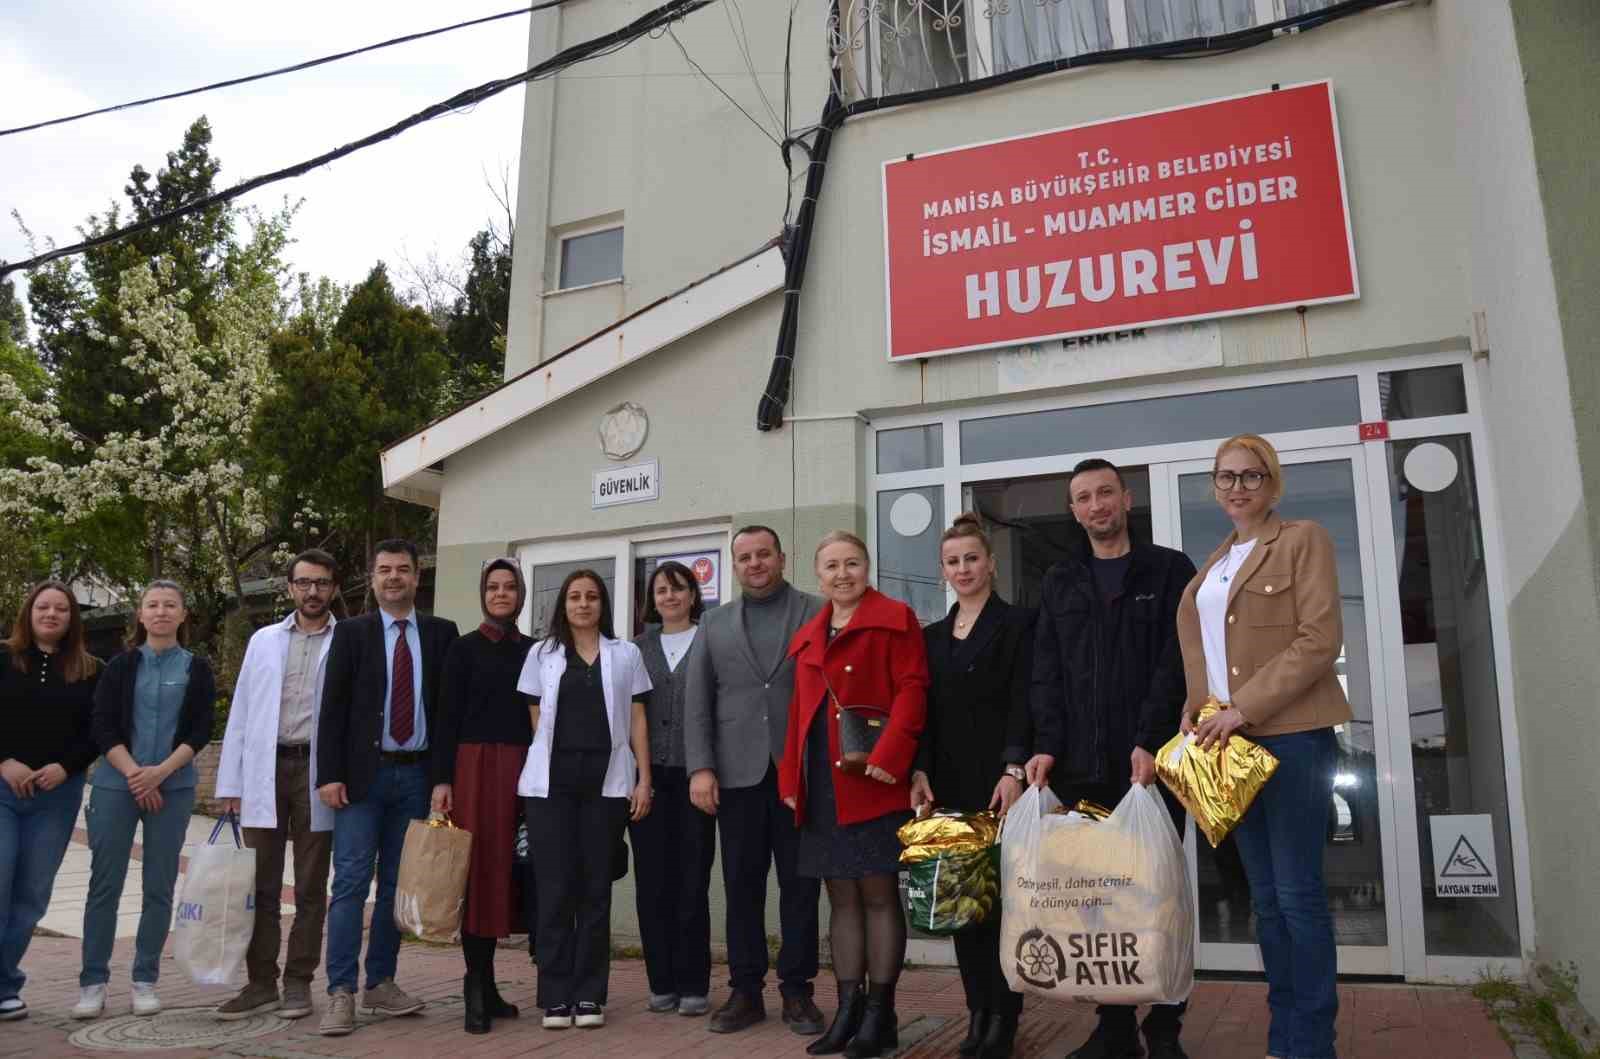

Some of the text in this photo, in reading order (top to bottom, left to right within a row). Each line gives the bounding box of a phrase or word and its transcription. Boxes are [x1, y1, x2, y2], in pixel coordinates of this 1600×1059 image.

[1078, 148, 1119, 169] T.C.
[923, 136, 1292, 219] MANİSA BÜYÜKŞEHİR BELEDİYESİ
[923, 217, 1017, 257] İSMAİL
[1044, 191, 1197, 237] MUAMMER
[1205, 176, 1298, 211] CİDER
[965, 218, 1259, 319] HUZUREVİ
[1365, 424, 1382, 437] 24
[599, 472, 651, 497] GÜVENLİK
[1064, 876, 1096, 889] daha
[1438, 882, 1498, 895] KAYGAN ZEMİN
[1040, 896, 1079, 911] dünya
[1067, 931, 1139, 958] SIFIR
[1075, 960, 1145, 985] ATIK
